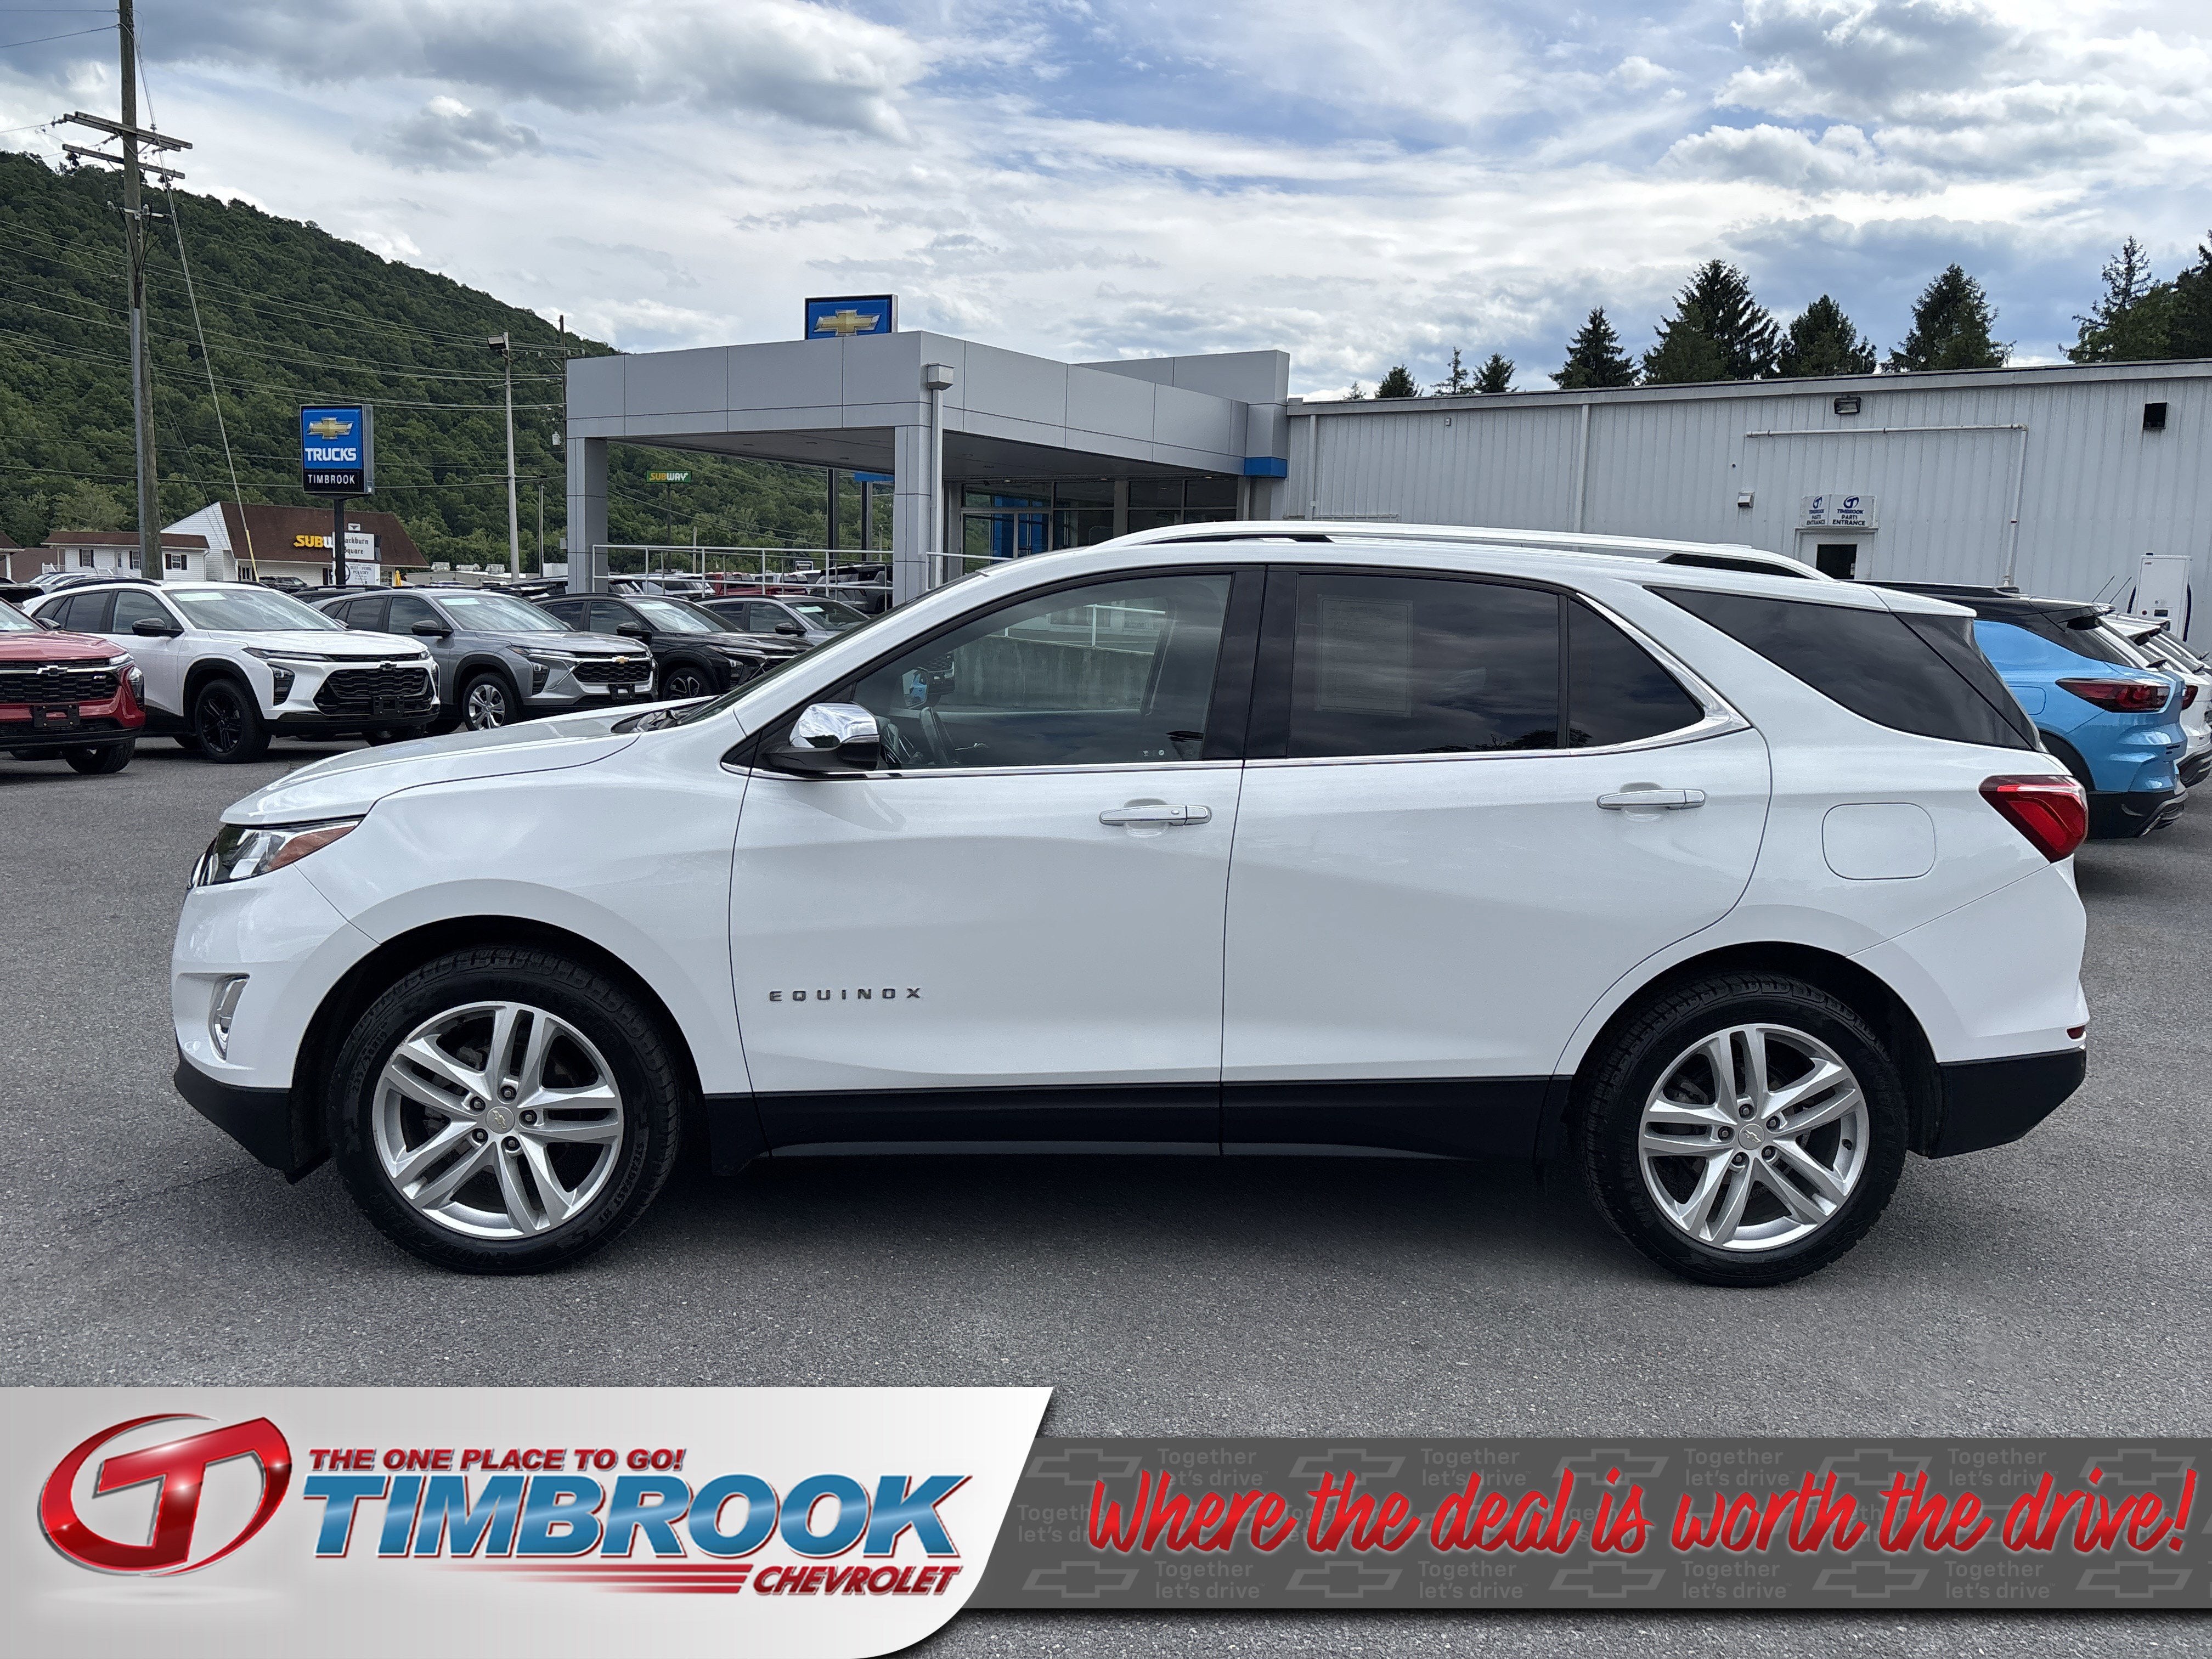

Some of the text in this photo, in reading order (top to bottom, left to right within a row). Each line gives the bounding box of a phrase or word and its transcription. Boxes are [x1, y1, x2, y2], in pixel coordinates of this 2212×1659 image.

[304, 448, 357, 461] TRUCKS
[308, 474, 356, 484] TIMBROOK
[649, 472, 689, 481] SUBWAY
[294, 535, 334, 549] SUBW
[345, 536, 369, 545] ackburn
[769, 988, 920, 1002] EQUINOX
